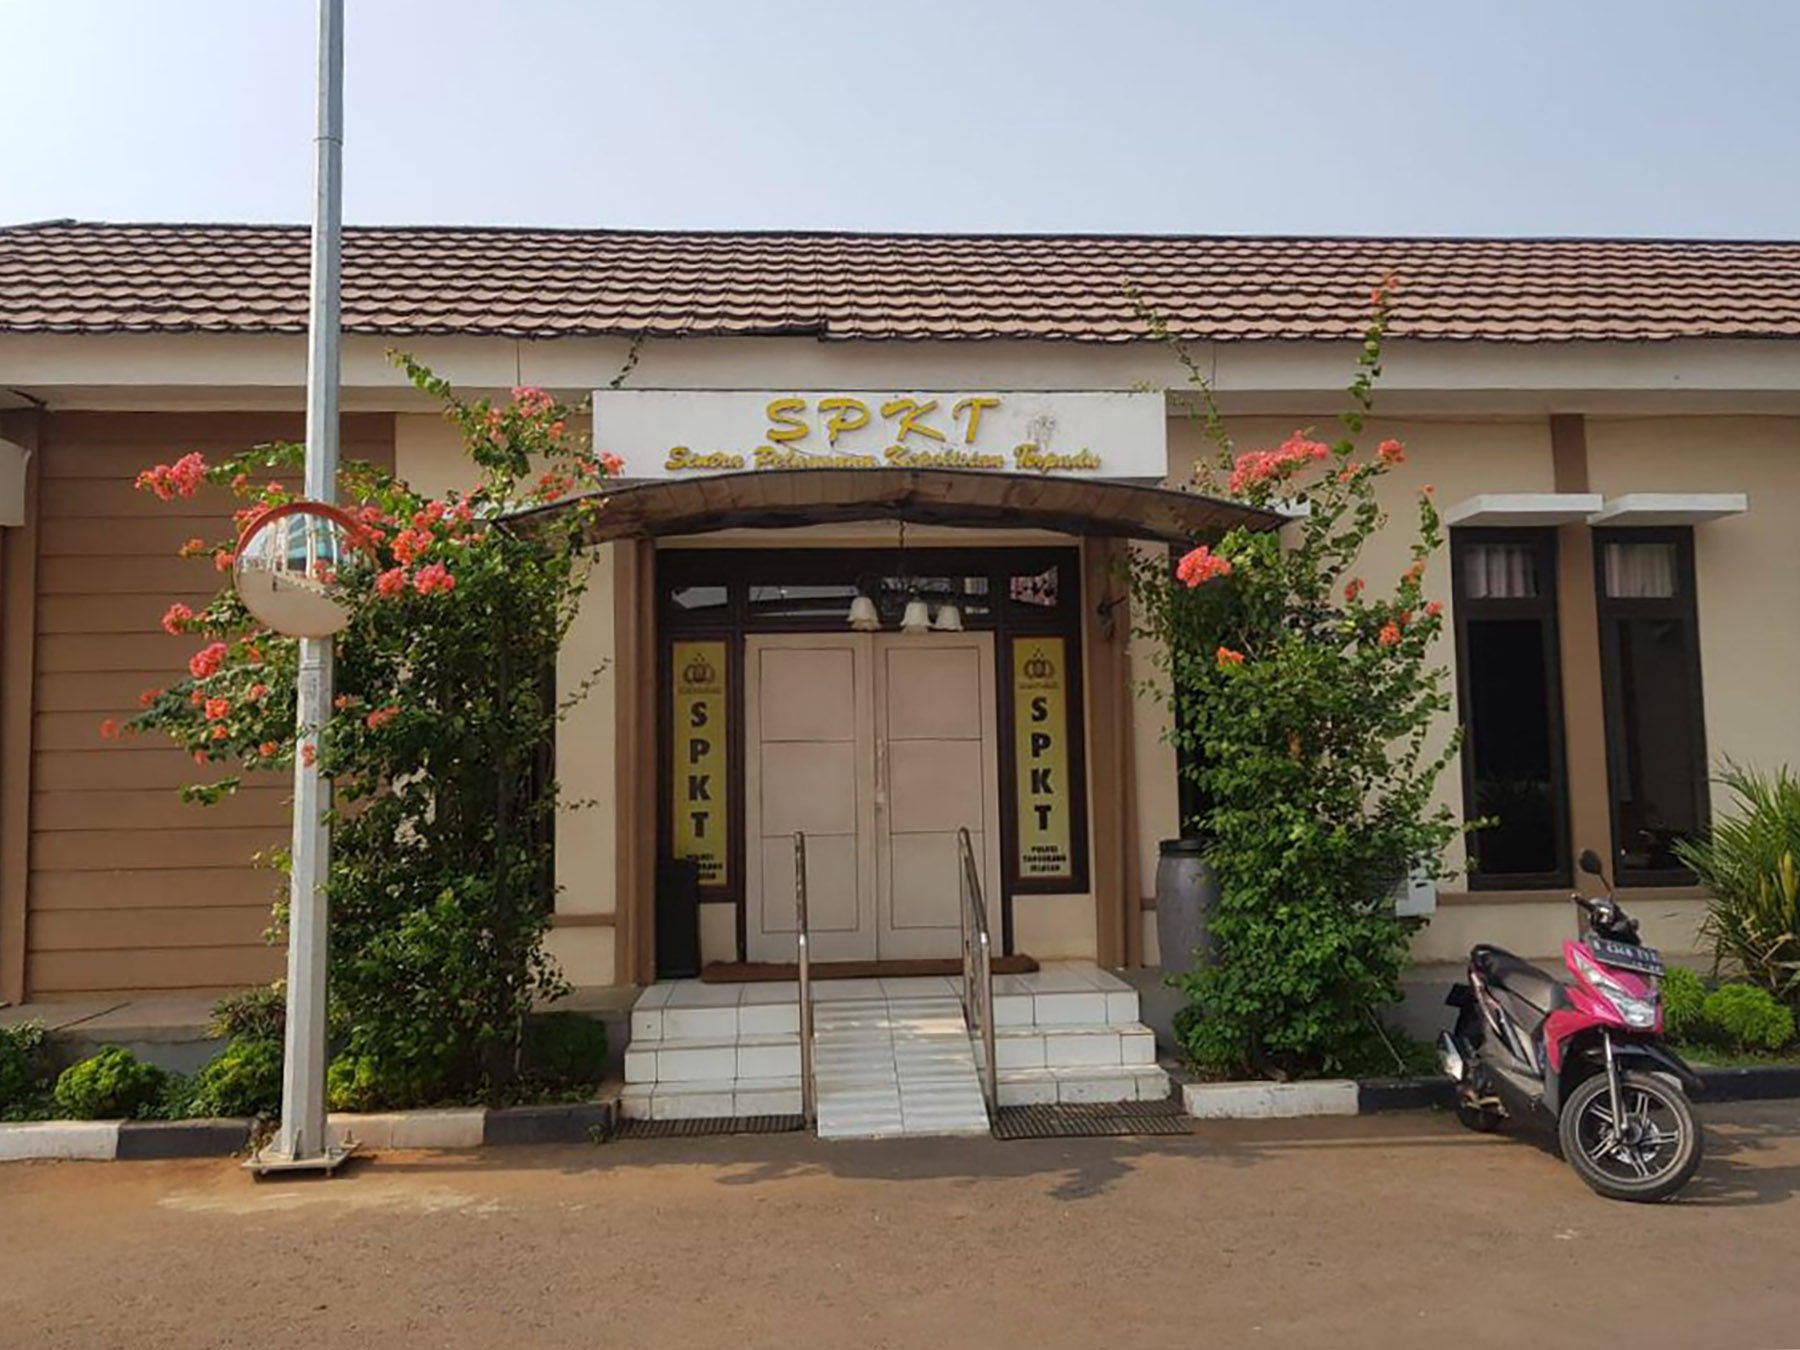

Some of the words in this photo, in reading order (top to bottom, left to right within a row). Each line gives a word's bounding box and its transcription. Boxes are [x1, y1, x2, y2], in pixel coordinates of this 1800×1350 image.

[665, 446, 744, 470] Sentra
[1013, 444, 1101, 474] Terpadu
[766, 397, 1000, 447] SPKT
[689, 702, 711, 838] SPKT
[1031, 697, 1053, 831] SPKT
